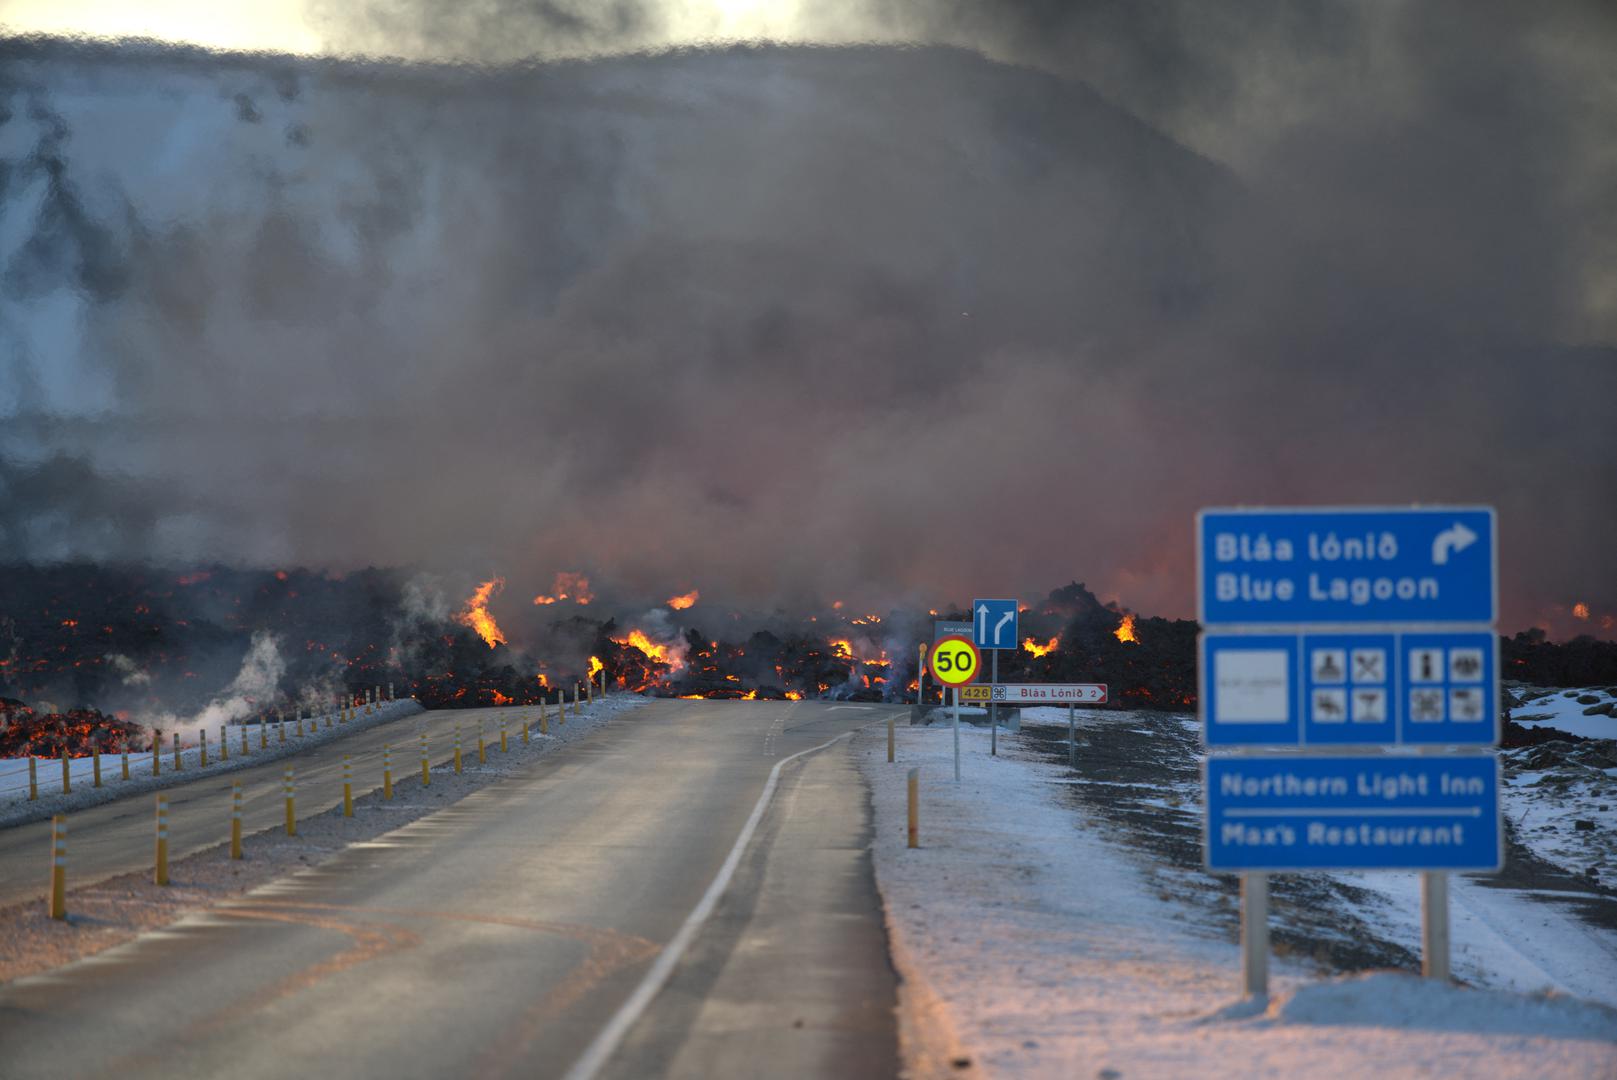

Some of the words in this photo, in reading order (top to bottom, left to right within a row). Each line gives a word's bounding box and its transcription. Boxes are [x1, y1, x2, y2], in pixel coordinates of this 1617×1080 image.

[1215, 532, 1294, 561] Bláa
[1215, 572, 1294, 602] Blue
[1308, 572, 1439, 605] Lagoon
[937, 651, 972, 672] 50
[964, 688, 989, 698] 426
[1021, 688, 1047, 698] Bláa
[1051, 688, 1084, 698] Lónið
[1090, 690, 1097, 698] 2
[1220, 772, 1348, 796] Northern
[1357, 772, 1429, 800] Light
[1441, 772, 1485, 796] Inn
[1221, 822, 1296, 846] Max's
[1307, 822, 1464, 846] Restaurant
